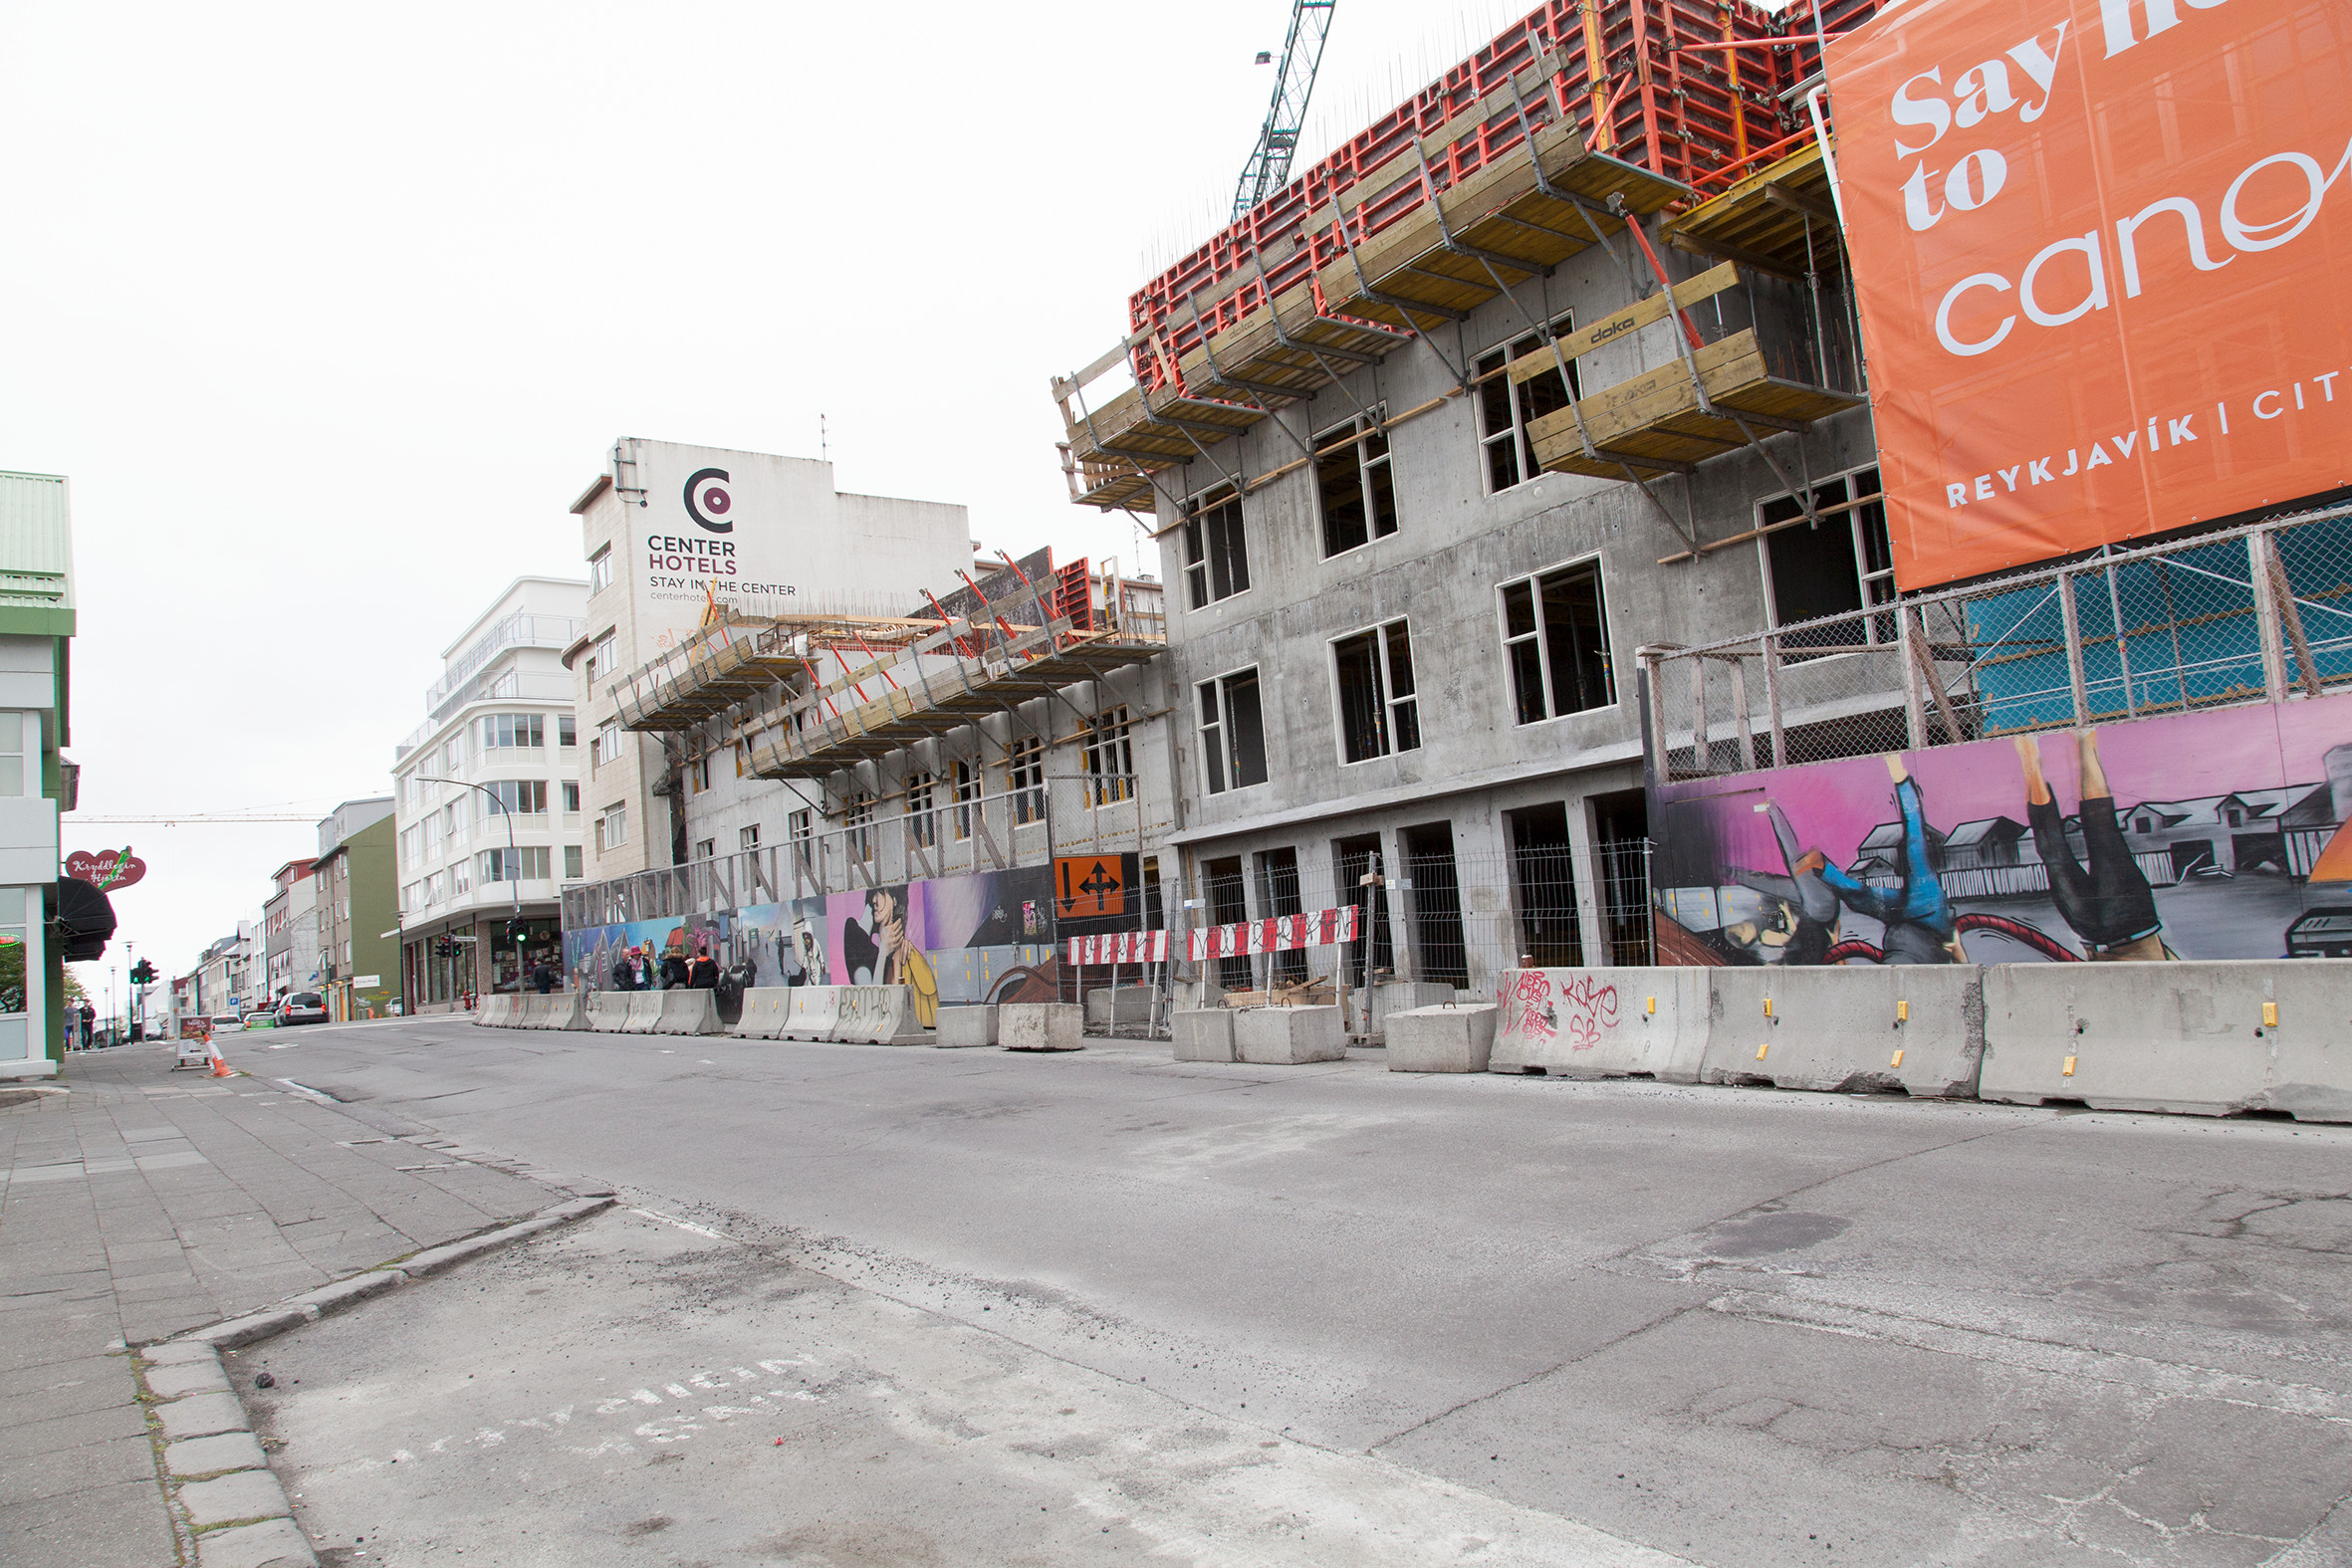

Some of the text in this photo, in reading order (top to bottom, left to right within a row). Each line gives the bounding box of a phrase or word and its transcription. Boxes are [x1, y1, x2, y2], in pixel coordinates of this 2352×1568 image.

[1891, 18, 2072, 161] Say
[1899, 148, 2007, 232] to
[1935, 136, 2352, 357] cano
[1590, 317, 1636, 344] doka
[1946, 414, 2198, 508] REYKJAVÍK
[2253, 364, 2352, 420] CIT
[648, 535, 736, 558] CENTER
[649, 554, 737, 575] HOTELS
[650, 575, 685, 588] STAY
[741, 582, 797, 596] CENTER
[650, 591, 738, 604] centerhotel.com
